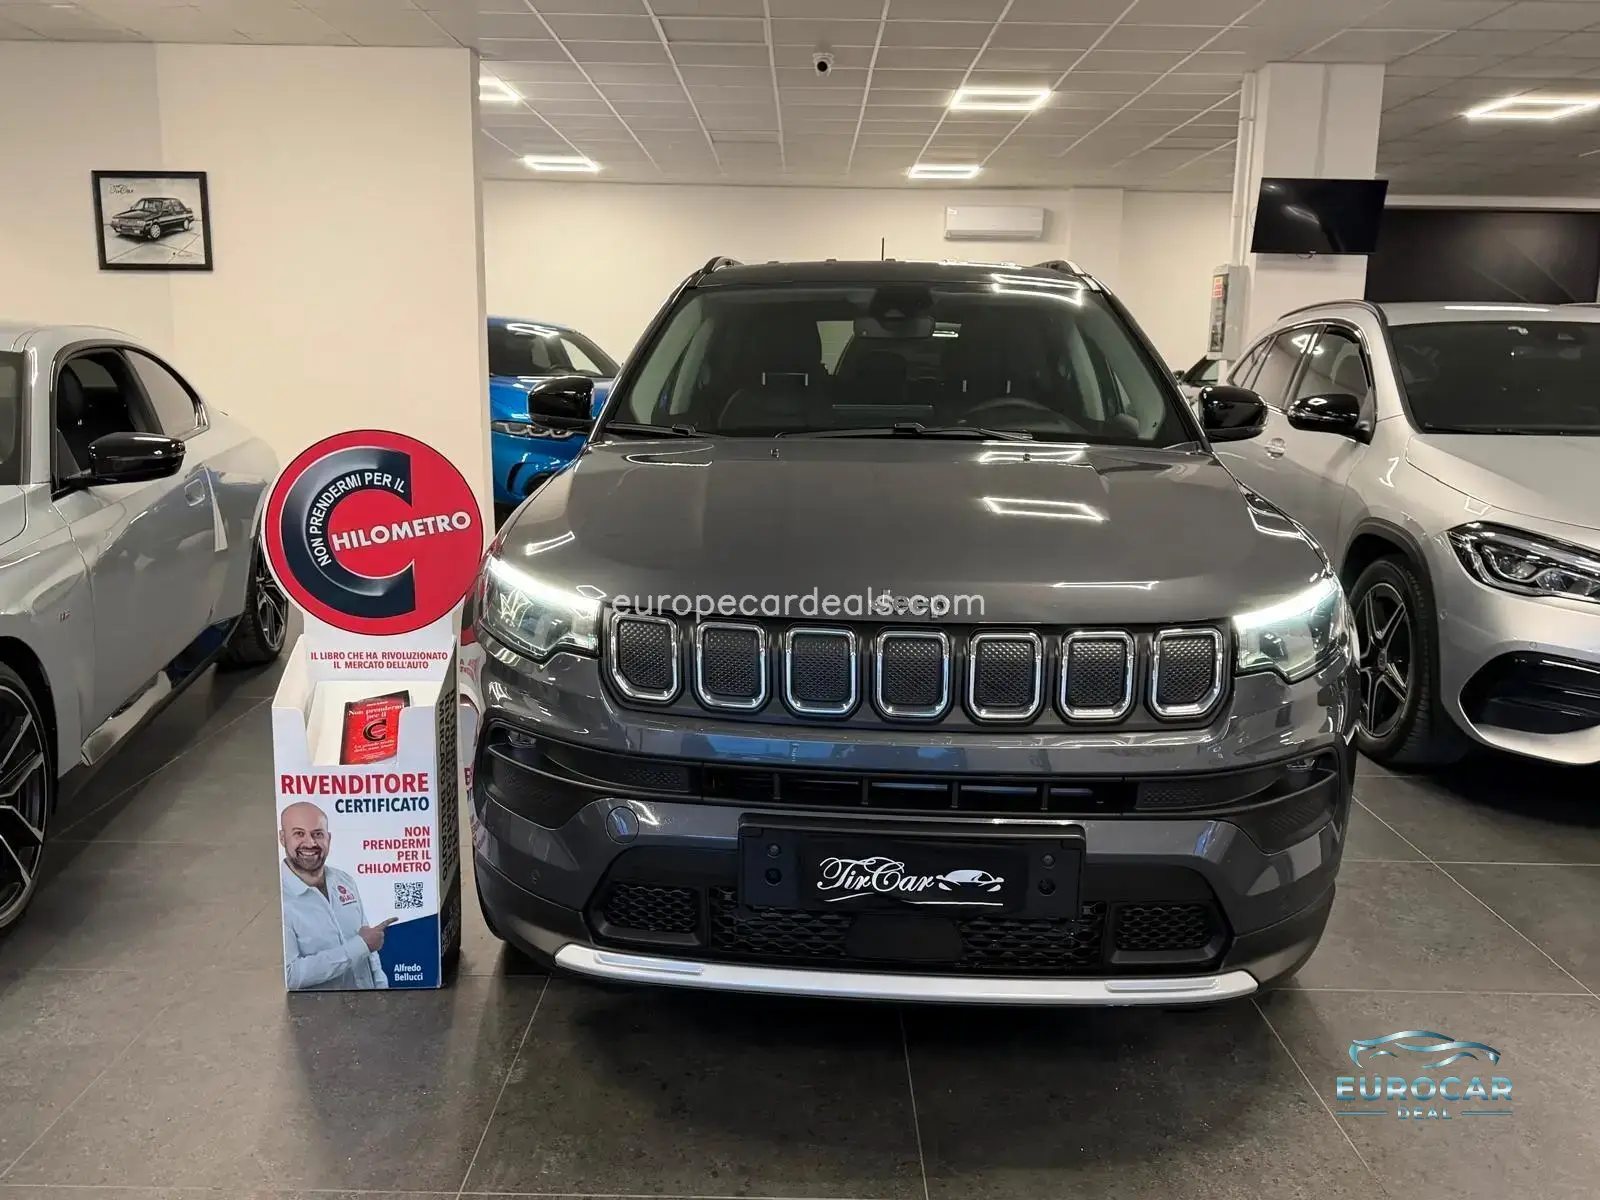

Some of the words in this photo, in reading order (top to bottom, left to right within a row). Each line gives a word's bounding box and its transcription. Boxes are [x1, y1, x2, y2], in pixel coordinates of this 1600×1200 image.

[365, 472, 392, 487] PER
[395, 477, 407, 494] IL
[310, 473, 362, 535] PRENDERMI
[311, 537, 332, 567] NON
[310, 652, 319, 660] IL
[320, 652, 345, 660] LIBRO
[347, 651, 364, 660] CHE
[366, 652, 378, 660] HA
[382, 651, 448, 660] RIVOLUZIONATO
[333, 661, 341, 669] IL
[345, 661, 384, 669] MERCATO
[386, 661, 429, 669] DELL'AUTO
[281, 773, 429, 795] RIVENDITORE
[335, 797, 430, 813] CERTIFICATO
[404, 827, 430, 836] NON
[363, 838, 430, 850] PRENDERMI
[397, 851, 418, 860] PER
[421, 850, 432, 860] IL
[357, 862, 431, 874] CHILOMETRO
[817, 856, 934, 892] TirCar
[394, 963, 421, 973] Alfredo
[394, 973, 423, 981] Bellucci
